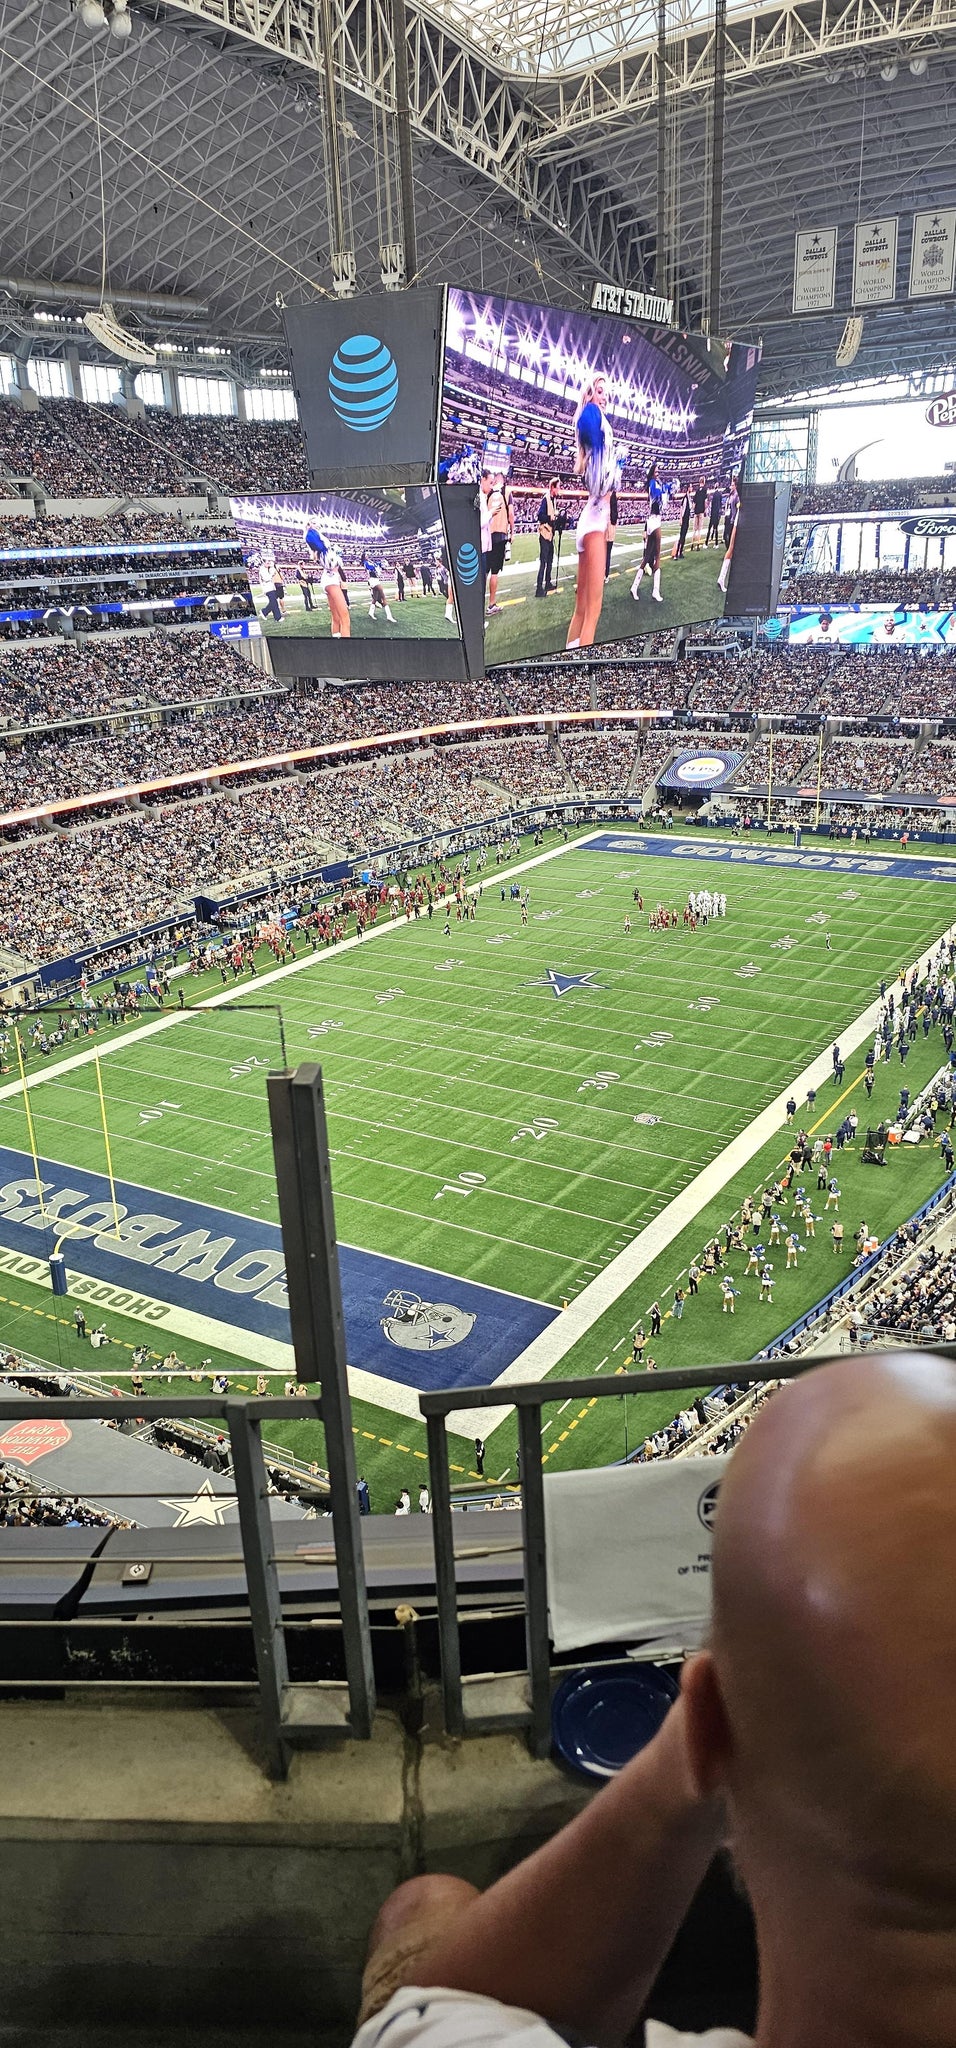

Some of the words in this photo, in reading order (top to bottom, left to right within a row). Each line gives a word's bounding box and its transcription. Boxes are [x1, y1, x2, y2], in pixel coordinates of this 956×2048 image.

[924, 228, 946, 237] DALLAS
[865, 238, 887, 246] DALLAS
[921, 235, 949, 244] COWBOYS
[805, 247, 826, 255] DALLAS
[862, 244, 889, 253] COWBOYS
[803, 253, 828, 261] COWBOYS
[863, 278, 885, 286] WORLD
[913, 276, 951, 286] CHAMPIONS
[856, 284, 892, 294] CHAMPIONS
[797, 292, 831, 302] CHAMPIONS
[591, 282, 625, 314] AT&T
[624, 289, 674, 324] STADIUM
[671, 844, 896, 872] COWBOYS
[770, 937, 799, 950] 30
[433, 958, 465, 971] 50
[733, 964, 762, 979] 40
[374, 986, 406, 1002] 40
[687, 996, 721, 1012] 50
[307, 1019, 344, 1036] 30
[640, 1031, 674, 1048] 40
[229, 1055, 271, 1075] 20
[582, 1071, 621, 1090] 30
[138, 1099, 183, 1121] 10
[517, 1117, 559, 1140] 20
[441, 1171, 487, 1198] 10
[13, 1425, 62, 1434] ARMY
[0, 1436, 67, 1446] SALVATION
[8, 1446, 40, 1455] THE
[697, 1554, 712, 1562] PR
[677, 1566, 690, 1575] OF
[692, 1565, 709, 1573] THE
